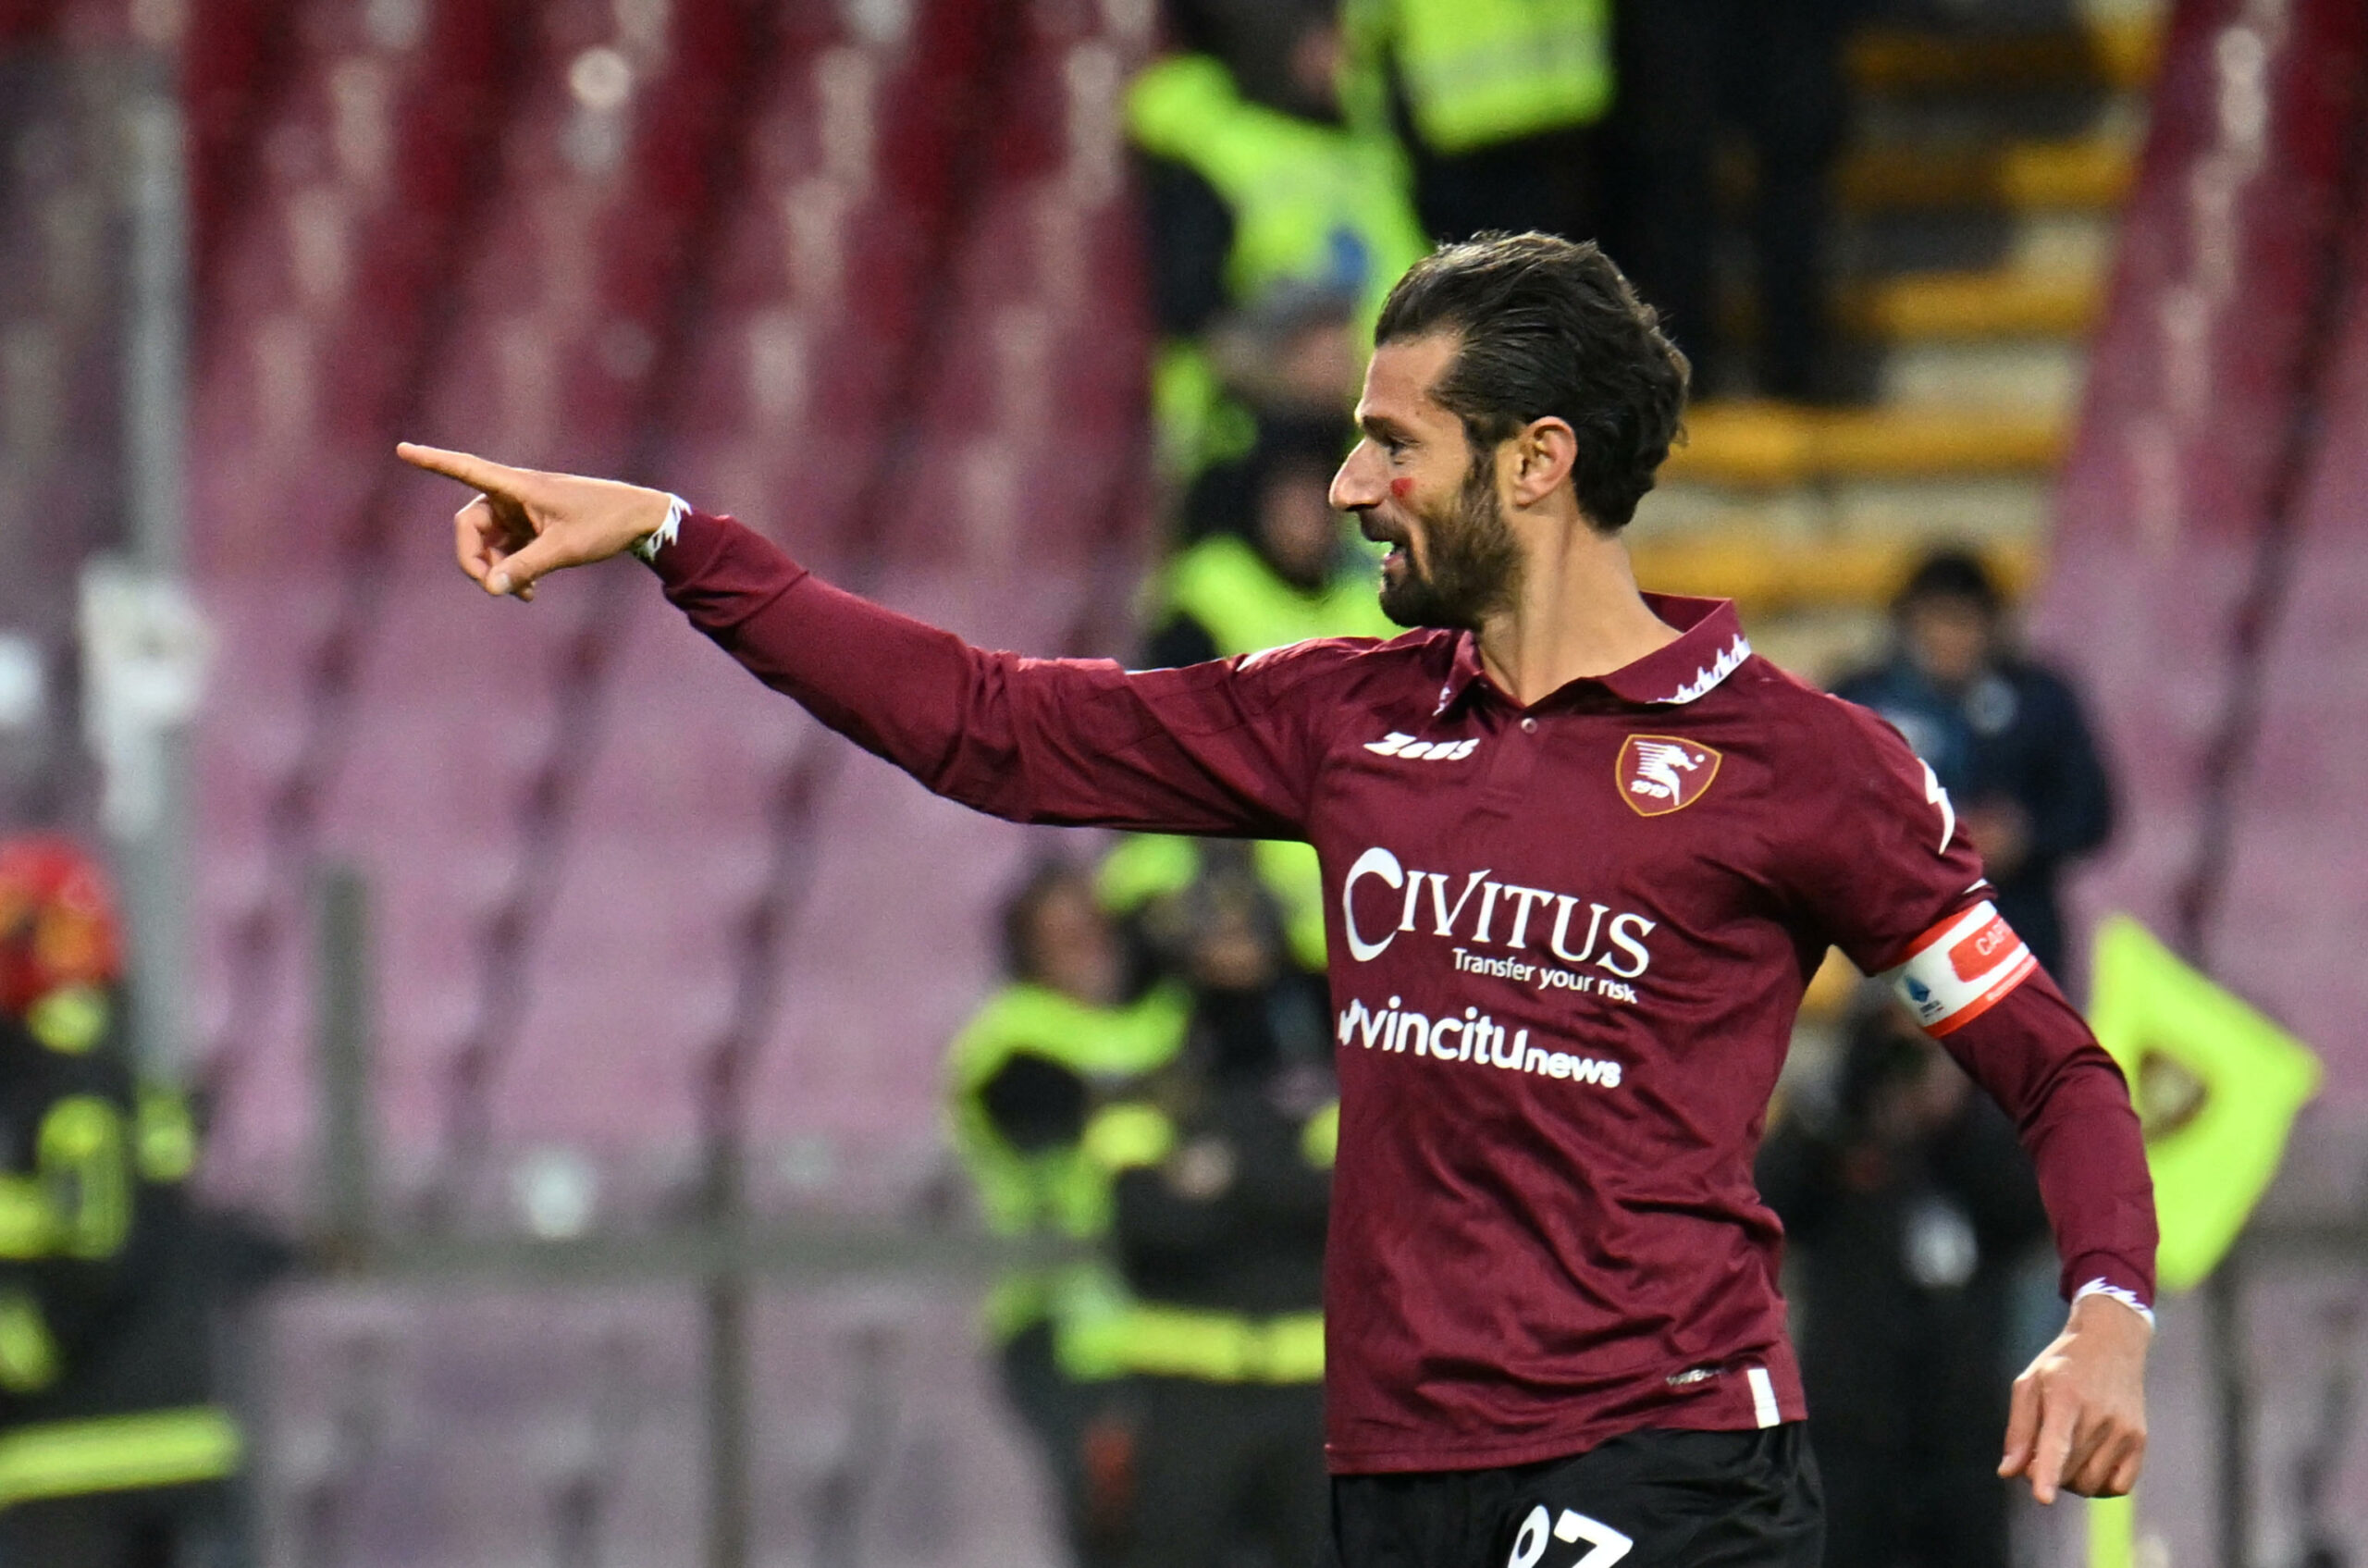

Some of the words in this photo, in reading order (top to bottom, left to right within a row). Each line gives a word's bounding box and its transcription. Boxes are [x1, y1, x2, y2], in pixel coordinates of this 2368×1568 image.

[1343, 846, 1657, 978] CIVITUS
[1452, 947, 1536, 982] Transfer
[1538, 968, 1594, 991] your
[1597, 979, 1637, 1004] risk
